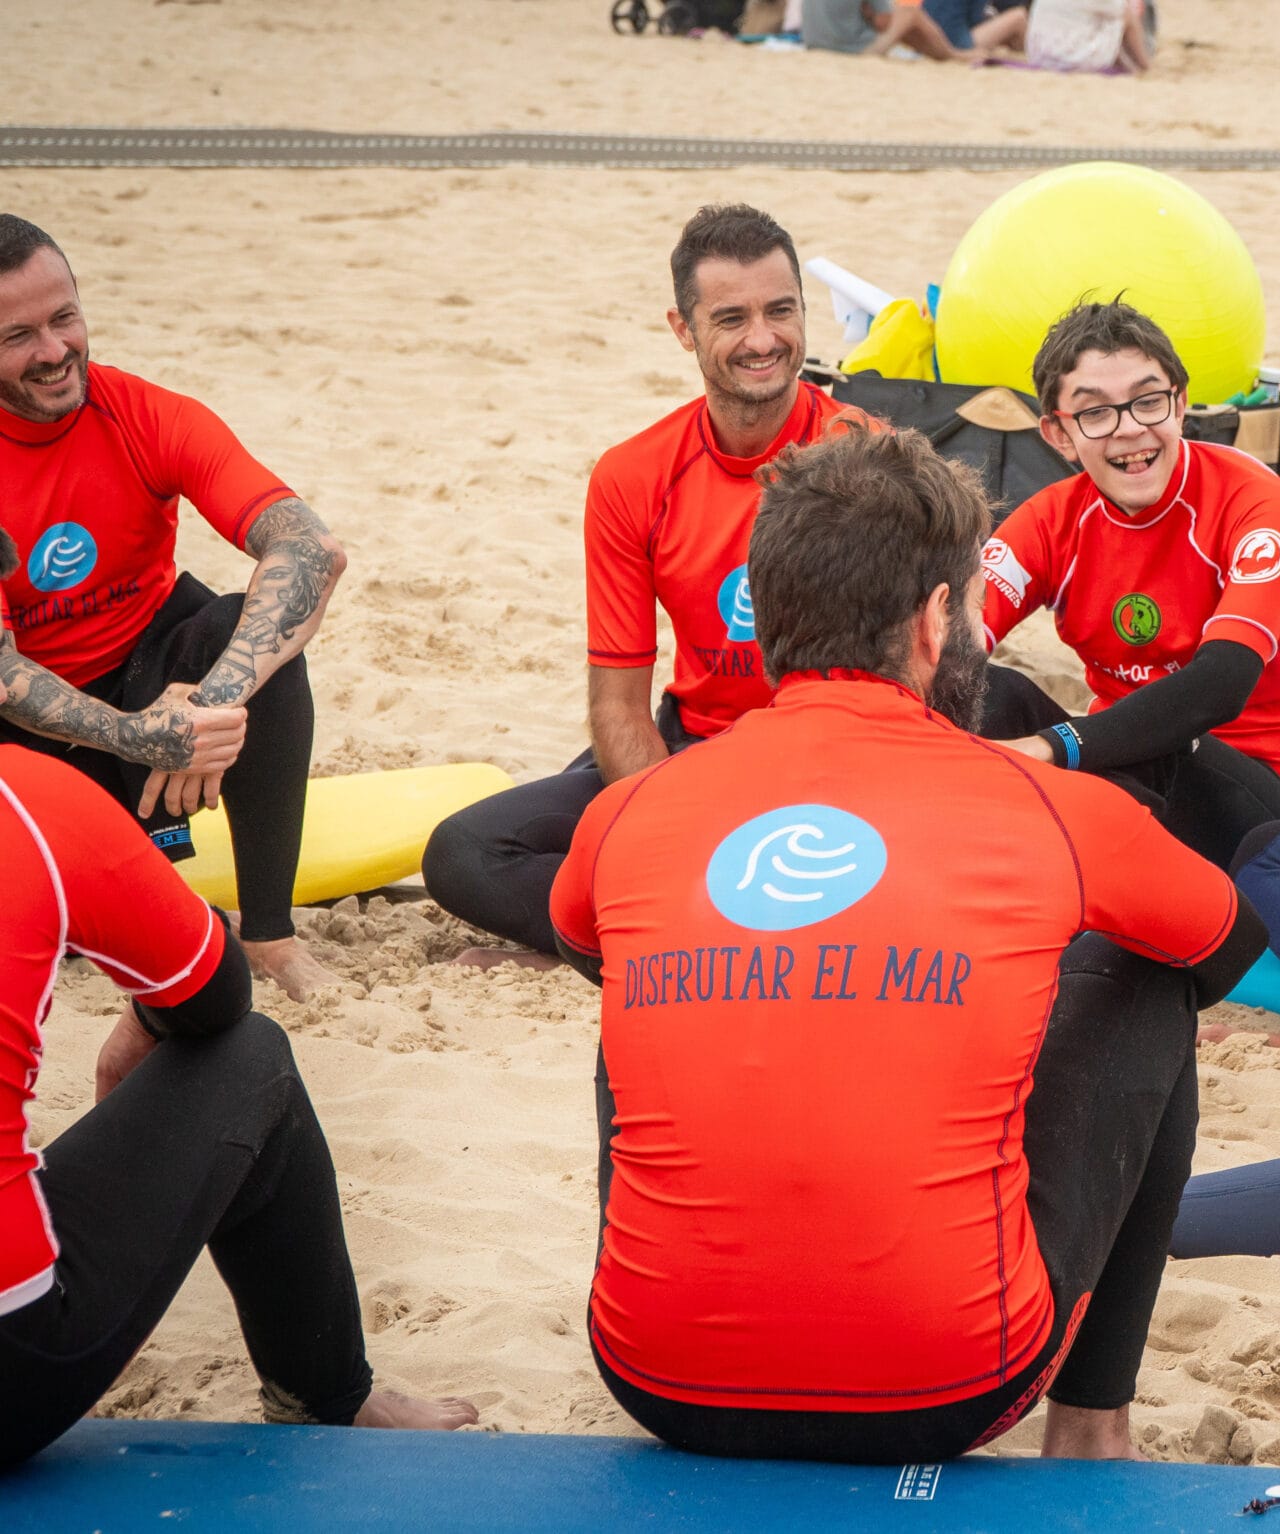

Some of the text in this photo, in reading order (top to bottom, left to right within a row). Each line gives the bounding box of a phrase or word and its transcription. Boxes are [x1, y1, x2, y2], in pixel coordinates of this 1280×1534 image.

[623, 944, 972, 1010] DISFRUTAR EL MAR
